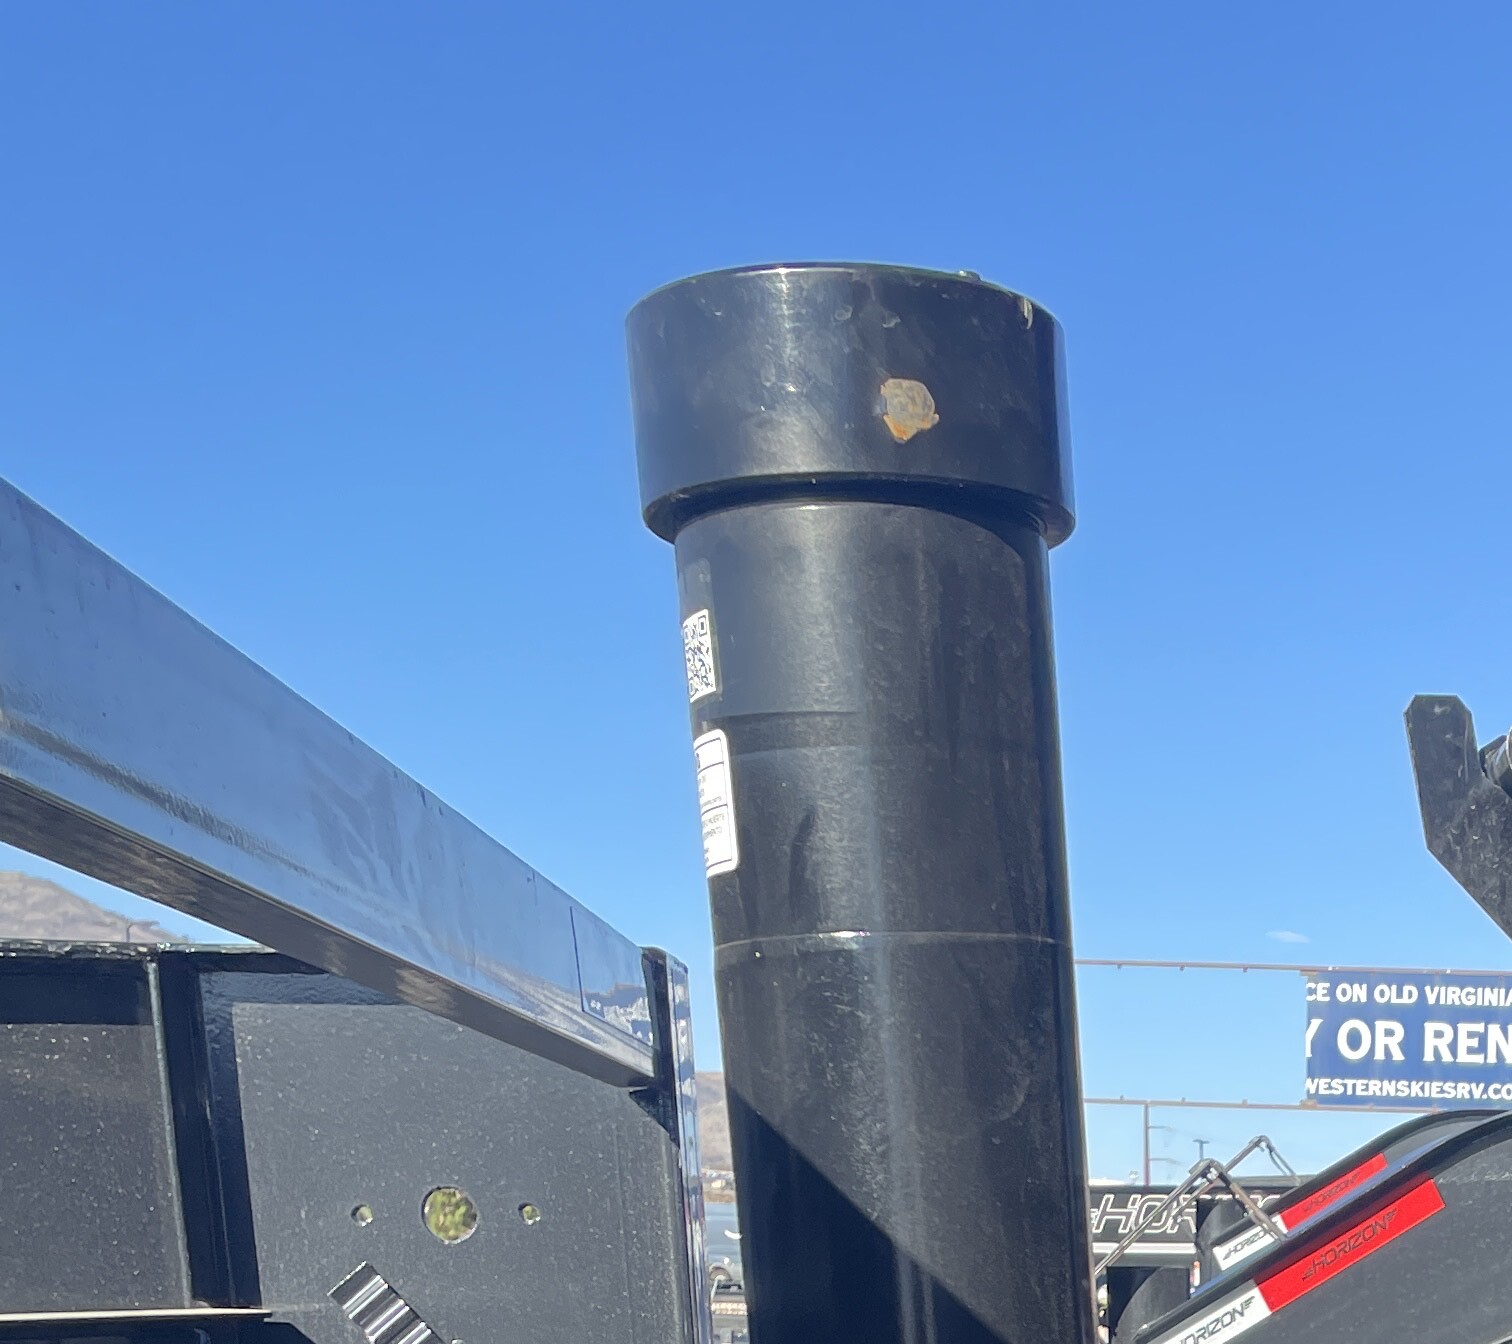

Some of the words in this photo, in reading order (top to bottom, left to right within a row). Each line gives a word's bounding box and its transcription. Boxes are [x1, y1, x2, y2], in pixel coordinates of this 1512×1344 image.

[1336, 983, 1367, 1003] ON
[1373, 984, 1418, 1004] OLD
[1337, 1018, 1405, 1061] OR
[1224, 1228, 1269, 1260] HORIZO
[1305, 1211, 1393, 1278] HORIZON
